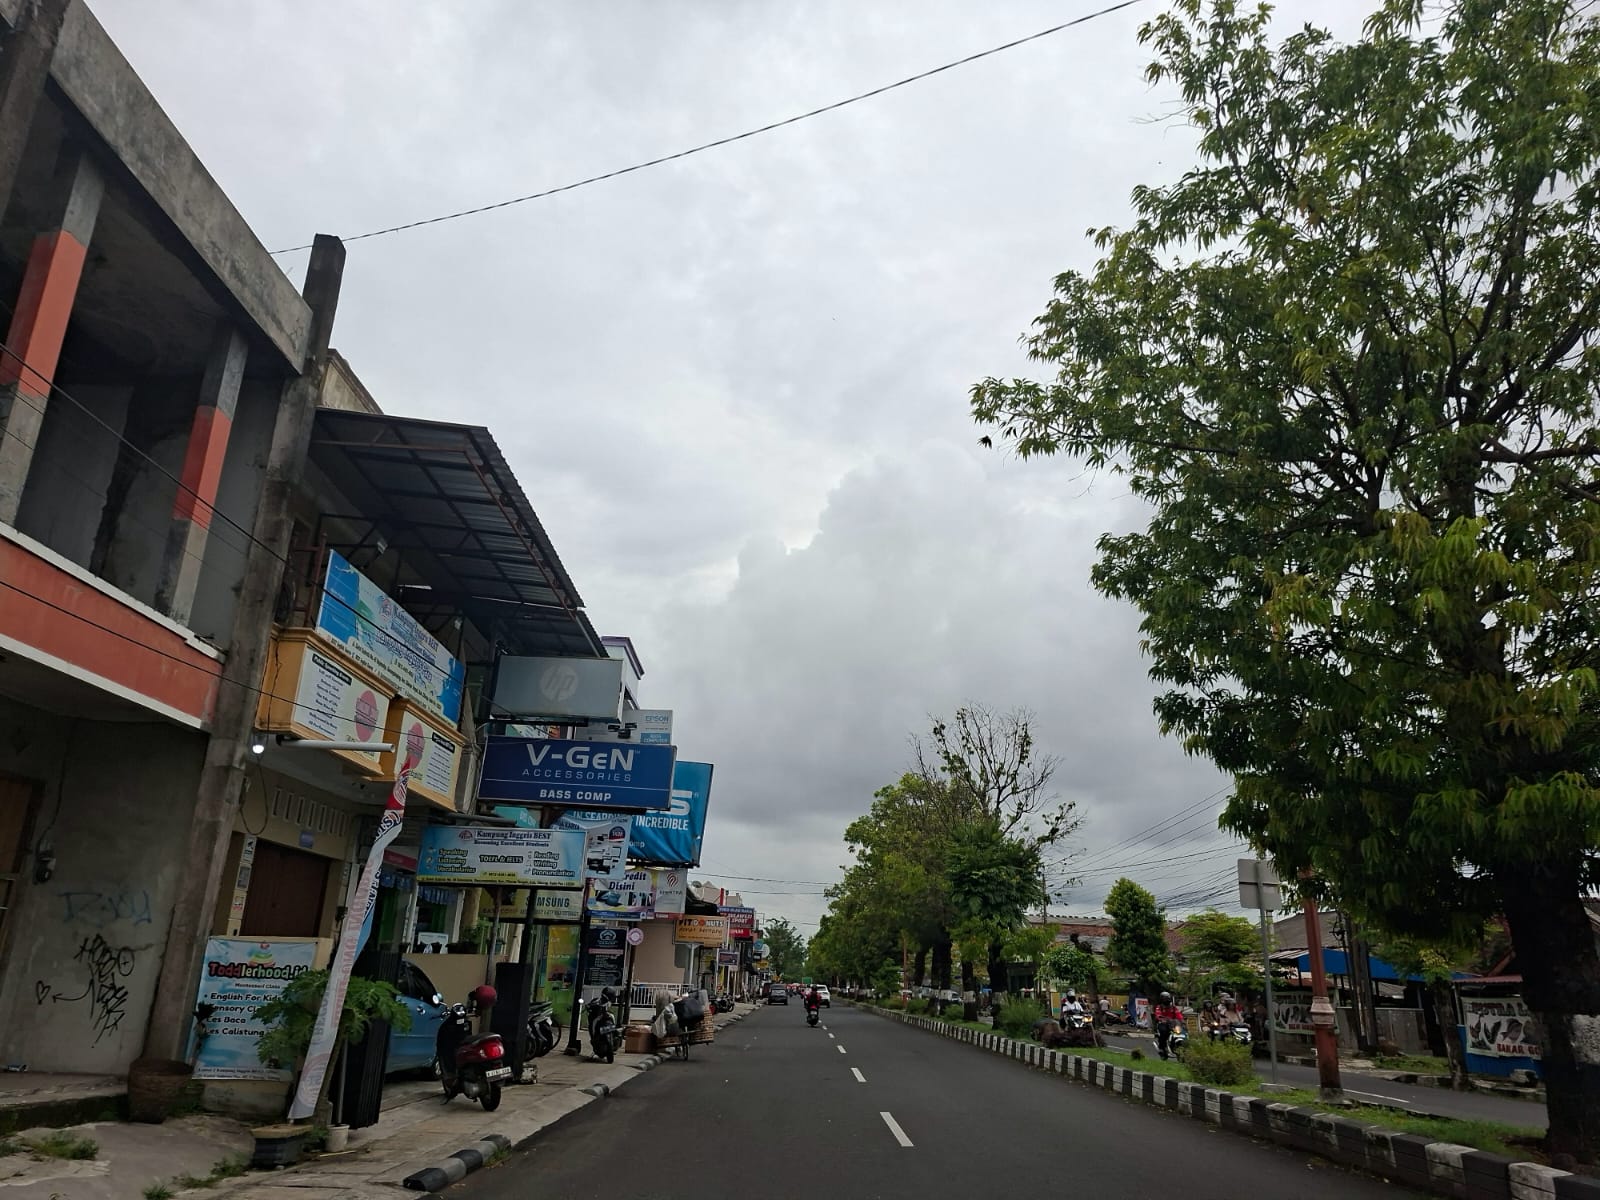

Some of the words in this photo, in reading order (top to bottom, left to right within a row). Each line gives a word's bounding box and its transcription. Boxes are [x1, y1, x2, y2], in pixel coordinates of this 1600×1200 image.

[522, 768, 632, 782] ACCESSORIES
[539, 788, 572, 800] BASS
[576, 791, 612, 801] COMP
[635, 815, 689, 831] INCREDIBLE
[476, 830, 507, 840] Kampung
[508, 831, 532, 840] Inggris
[533, 832, 551, 840] BEST
[624, 873, 647, 881] redit
[608, 882, 635, 891] Disini
[525, 896, 570, 907] SMSUNG
[210, 992, 243, 1001] English
[224, 1016, 246, 1024] Baca
[222, 1028, 265, 1038] Calistung
